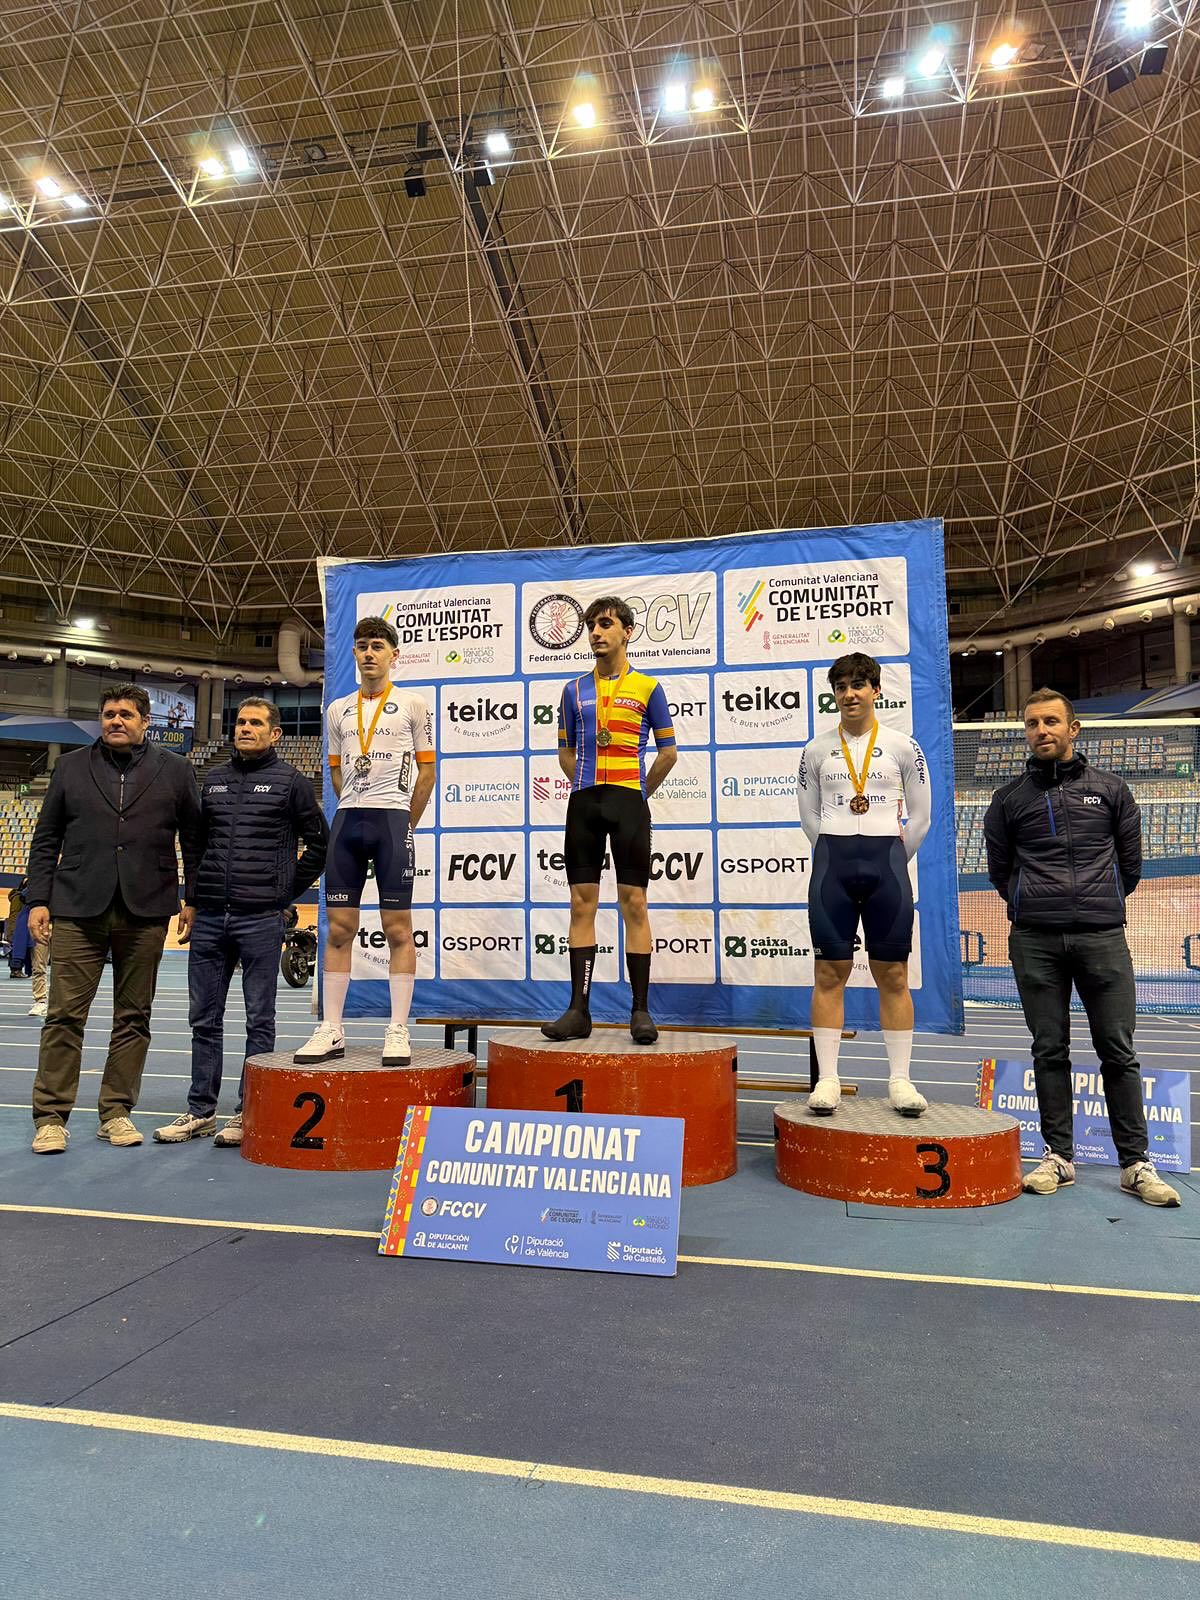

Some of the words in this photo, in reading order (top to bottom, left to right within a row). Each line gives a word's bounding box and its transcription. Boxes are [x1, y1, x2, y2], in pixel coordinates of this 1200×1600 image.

[769, 576, 821, 588] Comunitat
[823, 572, 879, 584] Valenciana
[768, 585, 879, 606] COMUNITAT
[396, 600, 442, 612] Comunitat
[443, 597, 491, 609] Valenciana
[776, 607, 800, 622] DE
[806, 600, 894, 620] L'ESPORT
[396, 608, 492, 628] COMUNITAT
[403, 629, 422, 644] DE
[428, 623, 503, 642] L'ESPORT
[848, 628, 884, 637] TRINIDAD
[848, 636, 884, 644] ALFONSO
[529, 652, 572, 662] Federació
[626, 649, 660, 658] munitat
[662, 647, 710, 656] Valenciana
[722, 686, 800, 712] teika
[874, 699, 906, 709] ular
[448, 698, 518, 722] teika
[667, 702, 706, 718] ORT
[739, 720, 759, 728] BUEN
[761, 713, 793, 728] VENDING
[163, 732, 184, 742] 2008
[454, 726, 462, 734] EL
[462, 729, 480, 738] BUEN
[482, 723, 511, 738] VENDING
[465, 782, 520, 792] DIPUTACIÓN
[661, 776, 698, 788] putació
[744, 775, 798, 786] DIPUTACIÓ
[465, 794, 476, 802] DE
[478, 794, 520, 802] ALICANTE
[554, 790, 568, 800] de
[666, 789, 706, 799] València
[866, 794, 886, 802] ime
[1084, 796, 1102, 804] FCCV
[448, 854, 516, 882] FCCV
[650, 852, 704, 880] CCV
[720, 858, 808, 874] GSPORT
[358, 927, 428, 948] tea
[442, 936, 522, 951] GSPORT
[750, 936, 788, 946] caixa
[650, 938, 712, 954] PORT
[750, 946, 810, 958] popular
[373, 957, 390, 965] BUEN
[554, 1078, 584, 1112] 1
[290, 1092, 326, 1150] 2
[464, 1119, 641, 1162] CAMPIONAT
[1076, 1144, 1104, 1152] Diputació
[916, 1143, 950, 1198] 3
[426, 1160, 538, 1190] COMUNITAT
[543, 1167, 672, 1198] VALENCIANA
[440, 1200, 488, 1218] FCCV
[429, 1232, 470, 1242] DIPUTACIÓN
[526, 1236, 564, 1247] Diputació
[436, 1242, 468, 1250] ALICANTE
[525, 1248, 535, 1256] de
[536, 1249, 568, 1259] València
[623, 1244, 662, 1255] Diputació
[634, 1254, 666, 1264] Castelló
